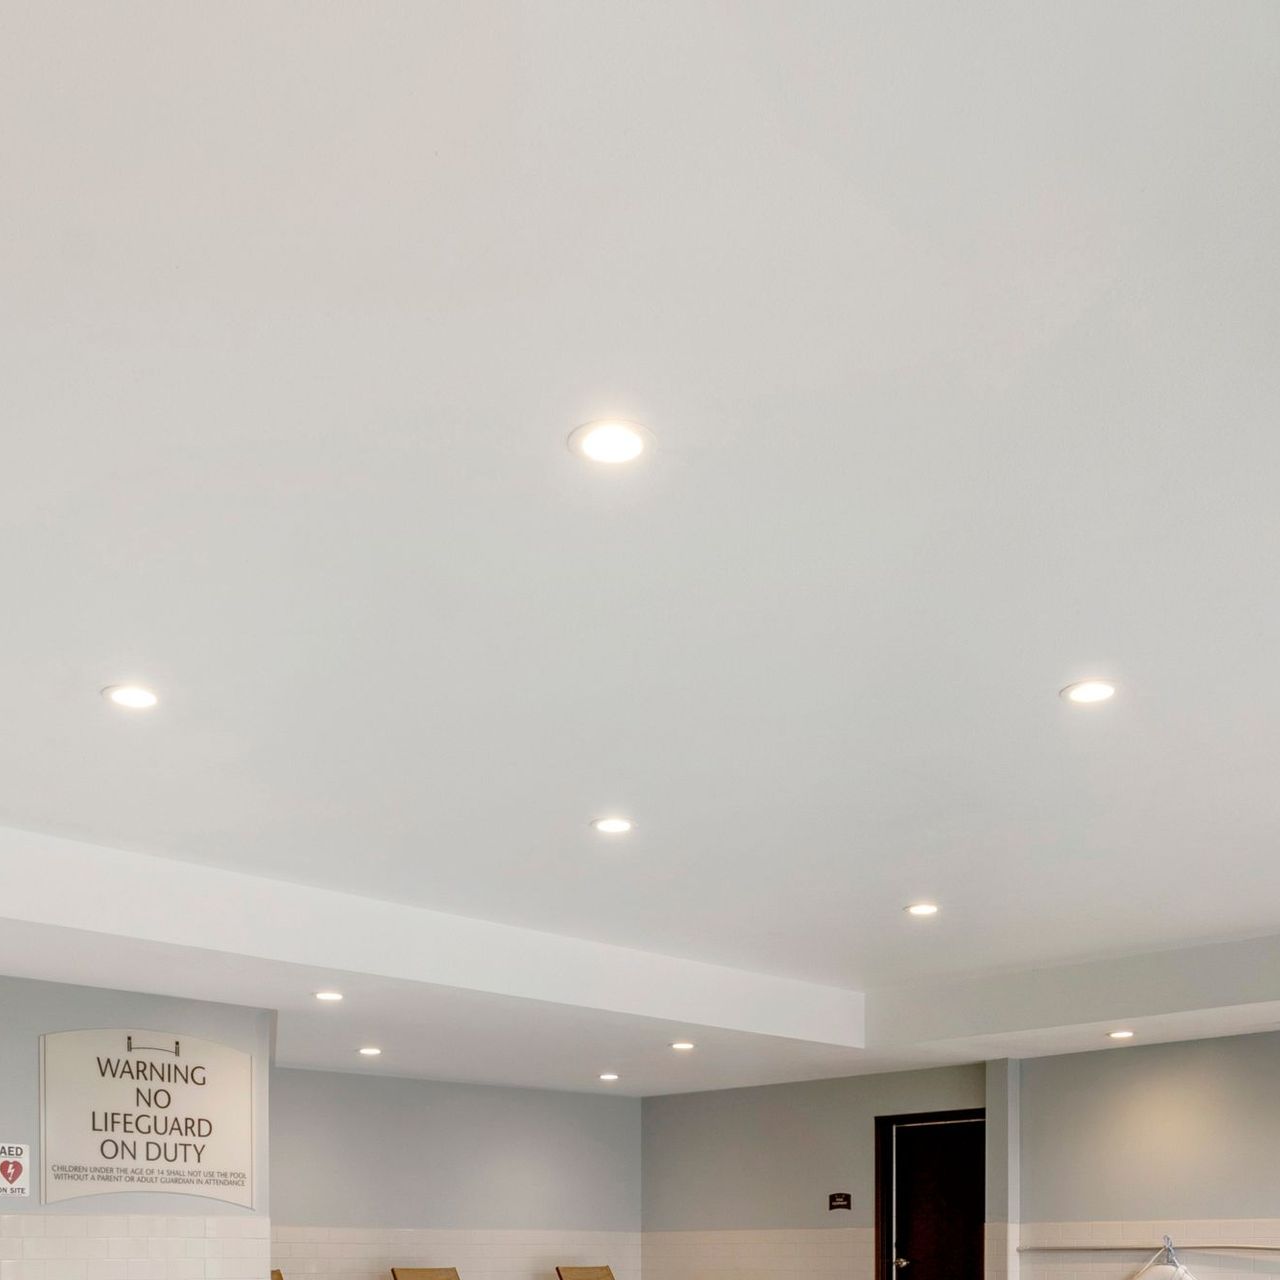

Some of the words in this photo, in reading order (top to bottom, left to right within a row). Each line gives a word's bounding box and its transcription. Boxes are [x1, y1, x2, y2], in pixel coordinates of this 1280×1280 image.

[97, 1057, 205, 1085] WARNING
[136, 1087, 171, 1109] NO
[92, 1111, 212, 1137] LIFEGUARD
[0, 1146, 23, 1156] AED
[101, 1139, 136, 1160] ON
[146, 1141, 205, 1163] DUTY
[52, 1165, 88, 1173] CHILDREN
[90, 1166, 114, 1174] UNDER
[166, 1169, 186, 1177] SHALL
[188, 1170, 201, 1178] NOT
[54, 1173, 88, 1181] WITHOUT
[97, 1174, 122, 1182] PARENT
[125, 1175, 135, 1183] OR
[137, 1176, 158, 1184] ADULT
[160, 1177, 195, 1185] GUARDIAN
[205, 1178, 245, 1186] ATTENDANCE
